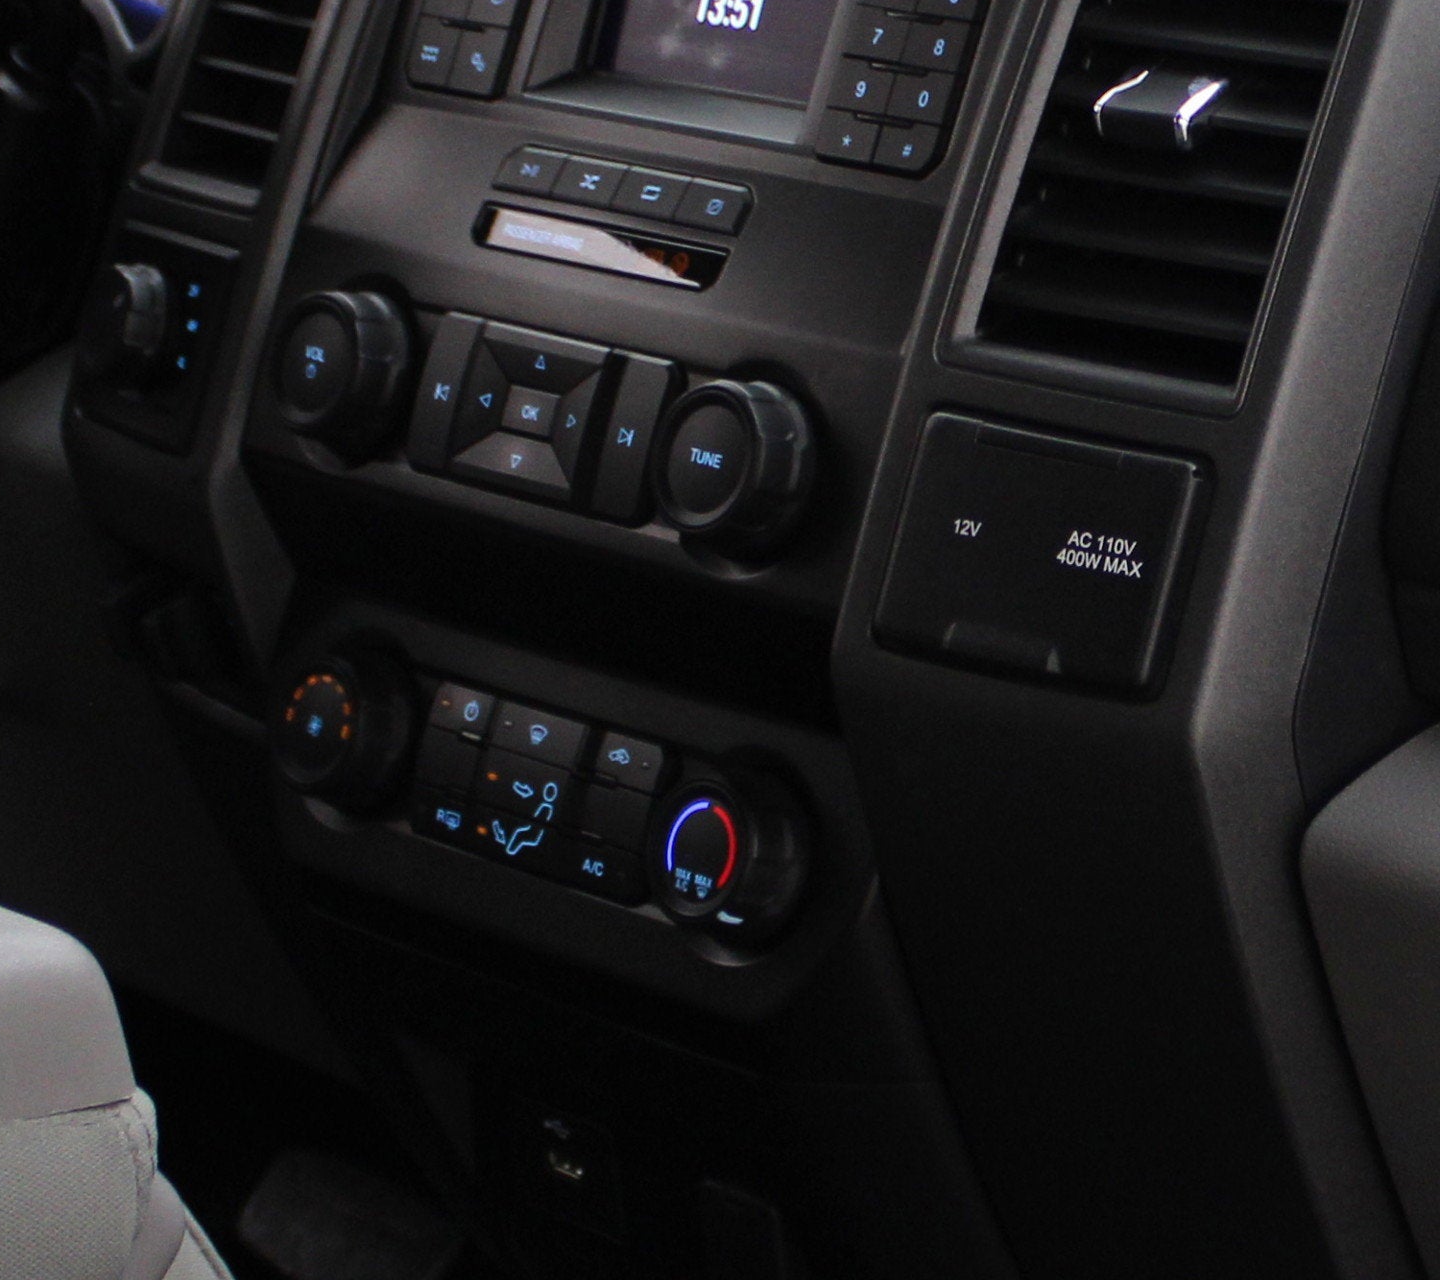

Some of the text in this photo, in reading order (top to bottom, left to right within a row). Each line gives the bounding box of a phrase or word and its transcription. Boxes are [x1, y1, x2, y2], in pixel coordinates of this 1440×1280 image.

[871, 27, 884, 45] 7
[933, 38, 946, 57] 8
[854, 80, 867, 98] 9
[917, 90, 930, 108] 0
[304, 345, 325, 363] VOL
[520, 404, 541, 422] OK
[690, 446, 724, 470] TUNE
[953, 518, 982, 537] 12V
[1067, 530, 1137, 557] AC 110V
[1056, 548, 1144, 579] 400W MAX
[582, 858, 605, 877] A/C
